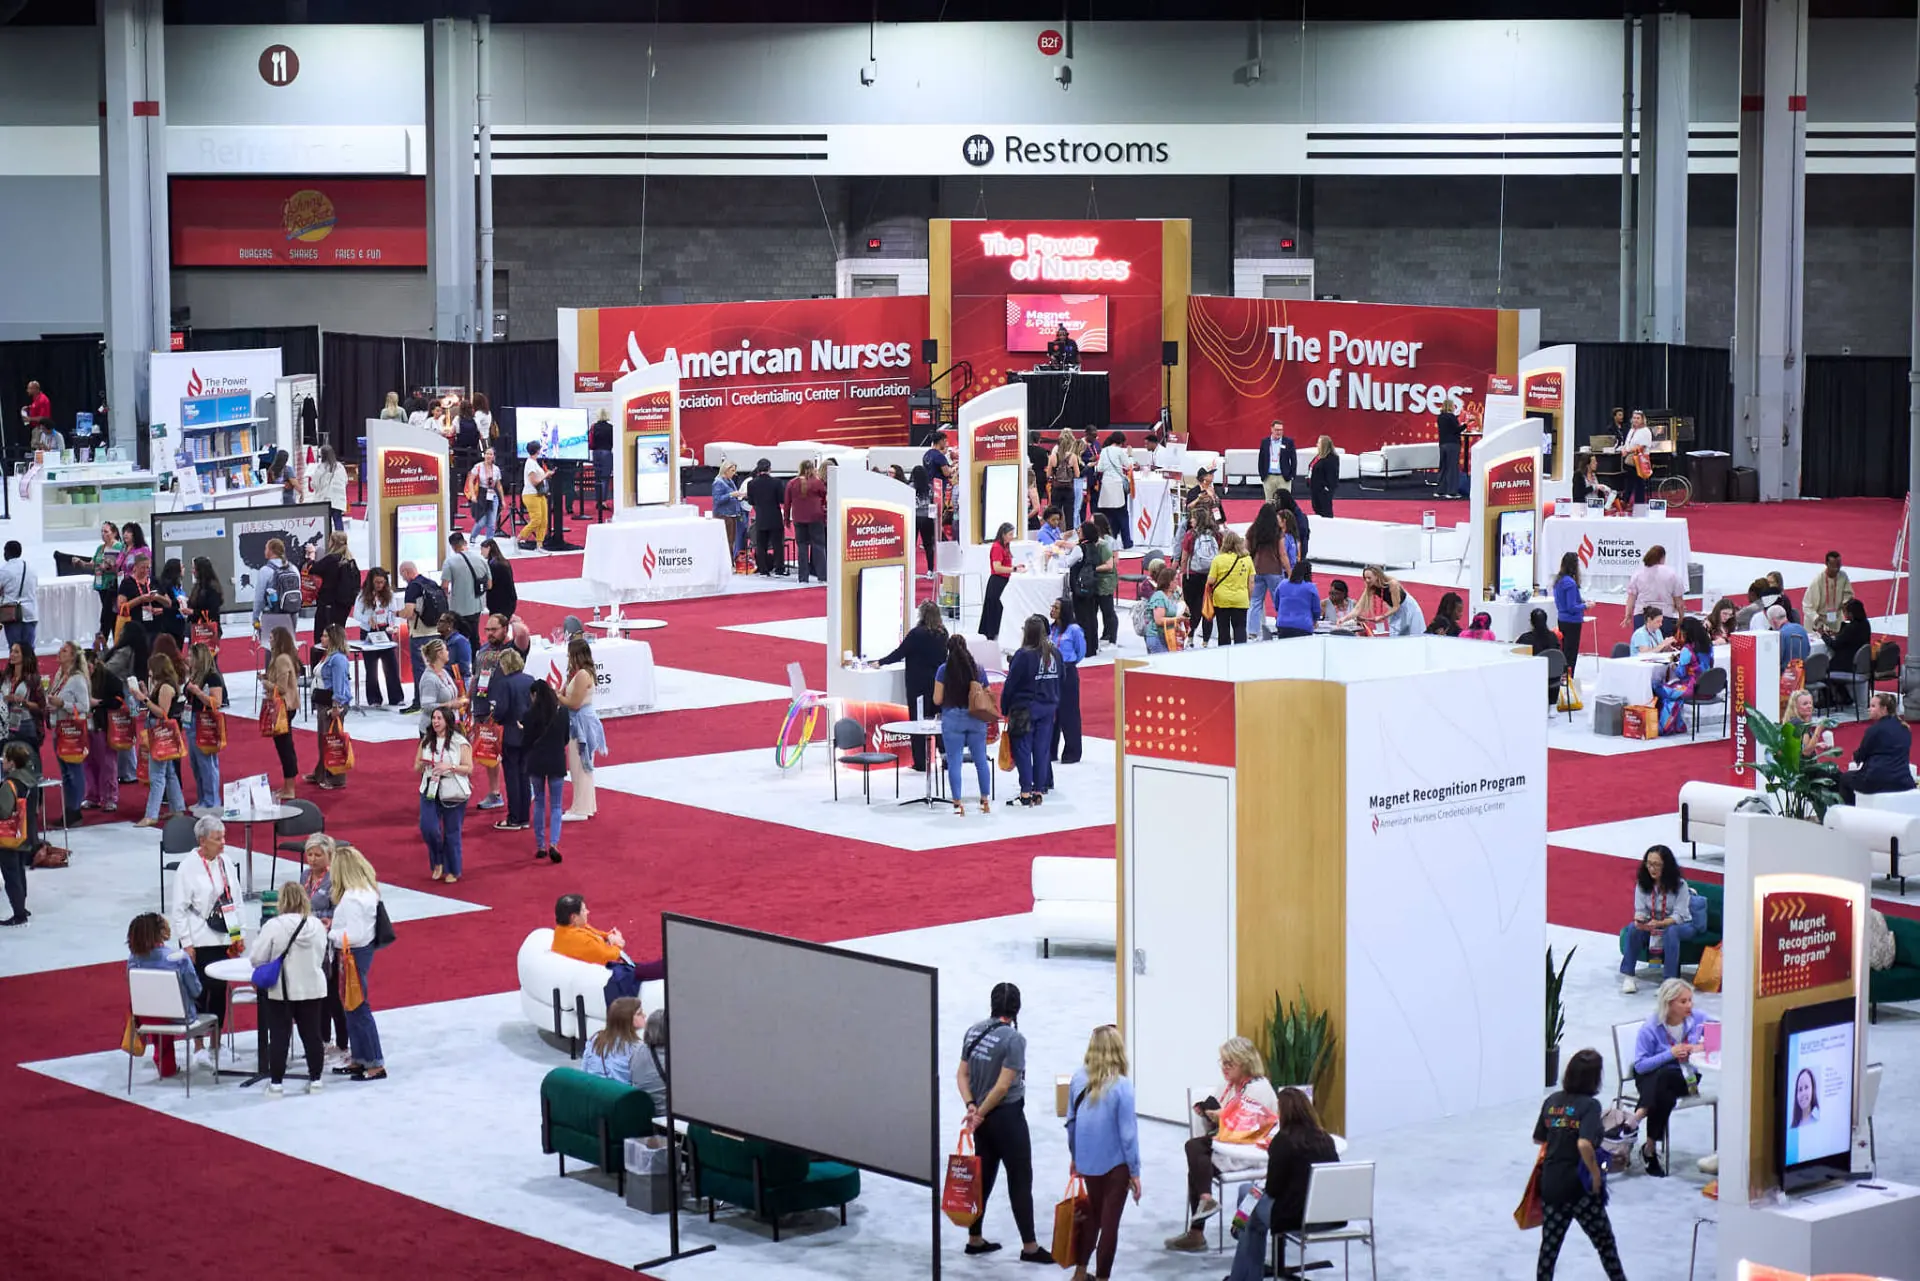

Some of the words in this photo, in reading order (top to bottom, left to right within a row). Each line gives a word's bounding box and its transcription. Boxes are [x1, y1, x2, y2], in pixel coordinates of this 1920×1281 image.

[1041, 36, 1060, 48] B2f
[1005, 135, 1169, 163] Restrooms
[239, 248, 273, 259] BURGERS
[289, 248, 318, 259] SHAKES
[335, 248, 355, 259] FRIES
[366, 248, 382, 259] FUN
[980, 231, 1024, 256] The
[1027, 233, 1099, 257] Power
[1010, 253, 1041, 280] of
[1026, 311, 1070, 322] Magnet
[1268, 325, 1321, 363] The
[1328, 330, 1423, 368] Power
[663, 339, 802, 379] American
[811, 339, 911, 373] Nurses
[205, 378, 221, 387] The
[222, 377, 248, 386] Power
[1306, 368, 1343, 408] of
[1531, 385, 1557, 393] Membership
[679, 394, 723, 409] ociation
[731, 390, 803, 406] Credentialing
[804, 388, 840, 402] Center
[850, 384, 911, 400] Foundation
[400, 467, 417, 475] Policy
[282, 518, 310, 531] VOTE
[658, 547, 687, 555] American
[658, 555, 693, 566] Nurses
[1597, 546, 1641, 557] Nurses
[1597, 558, 1640, 566] Association
[1735, 665, 1745, 713] Station
[1735, 715, 1747, 775] Charging
[1369, 791, 1410, 809] Magnet
[1413, 781, 1477, 802] Recognition
[1480, 775, 1526, 791] Program
[1380, 814, 1412, 828] American
[1413, 810, 1437, 823] Nurses
[1437, 803, 1483, 820] Credentialing
[1483, 801, 1505, 813] Center
[1789, 914, 1826, 934] Magnet
[1778, 930, 1836, 952] Recognition
